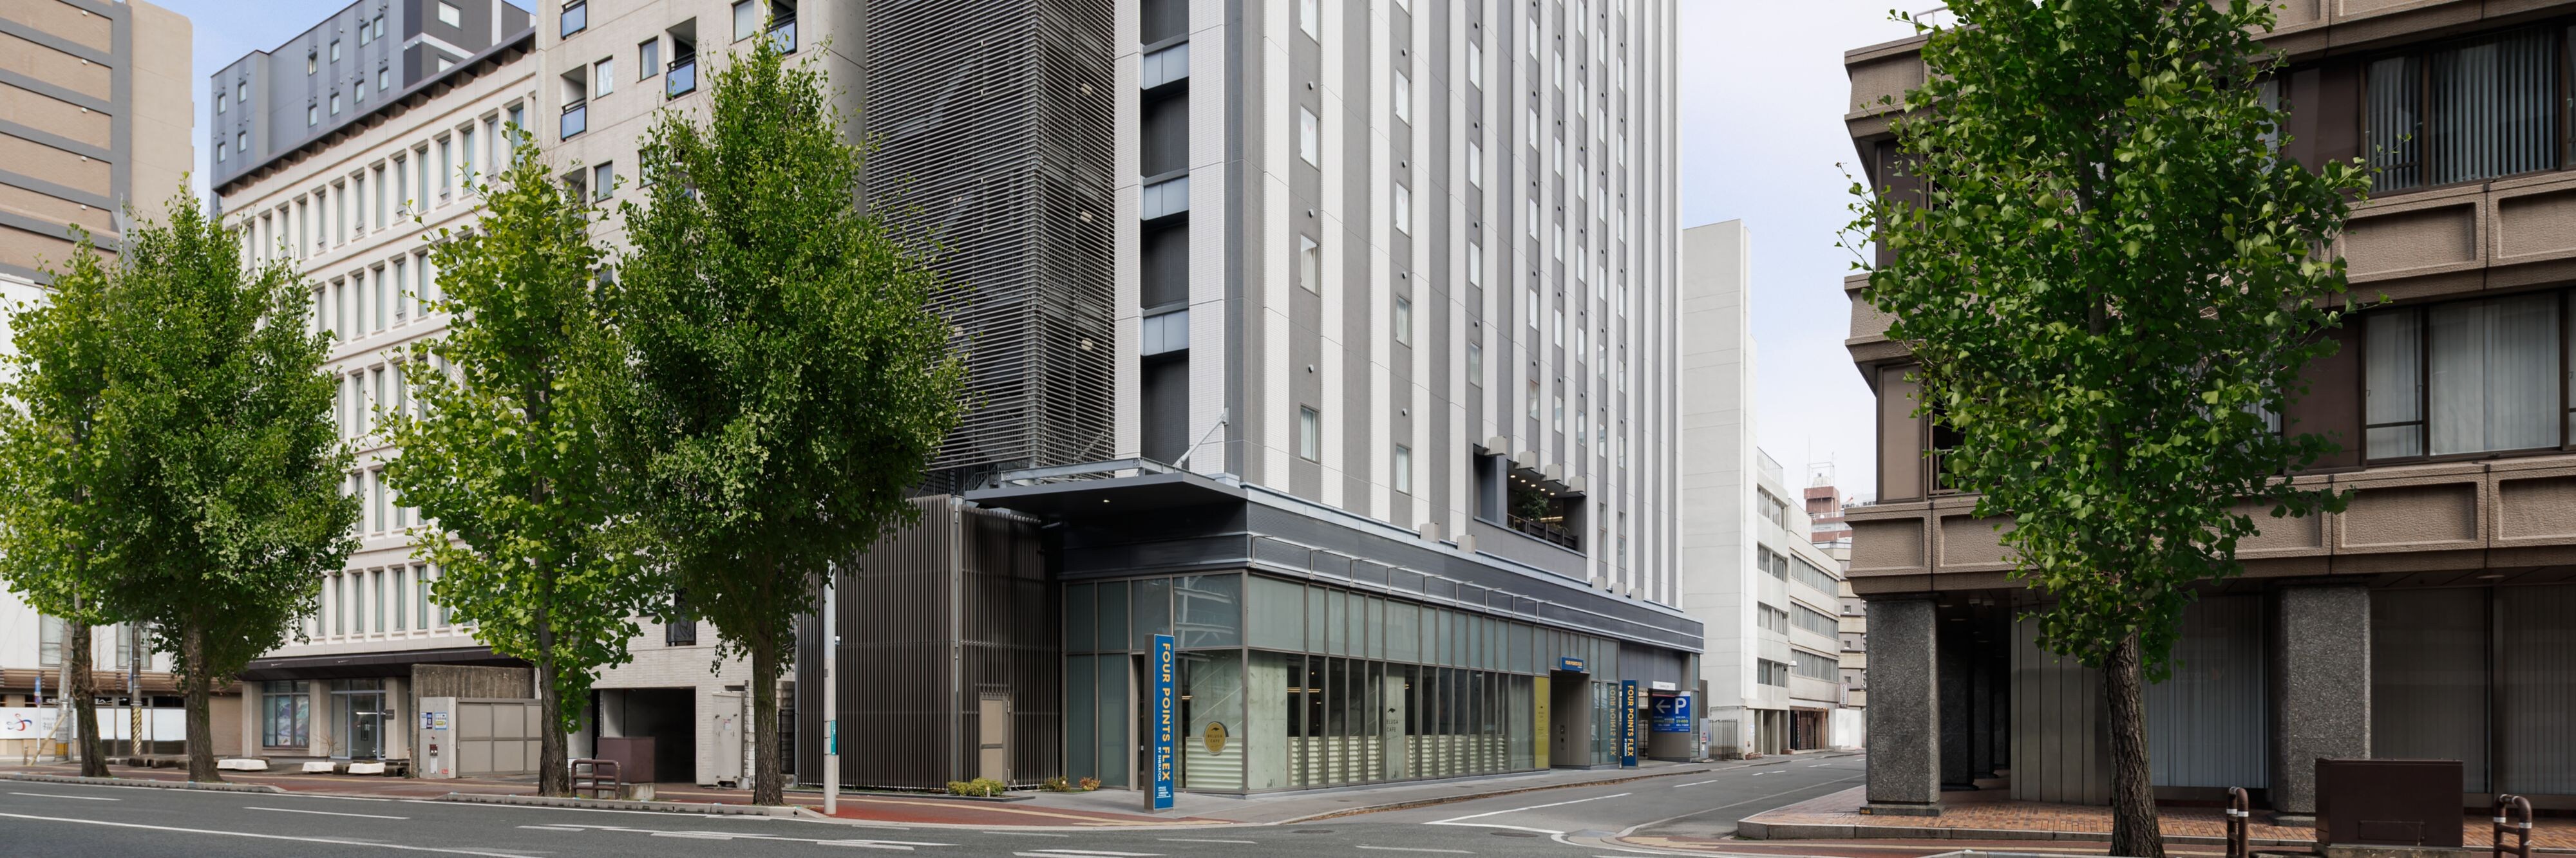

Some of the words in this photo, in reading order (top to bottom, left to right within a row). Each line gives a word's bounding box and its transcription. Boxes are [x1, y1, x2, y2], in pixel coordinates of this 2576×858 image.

[1162, 643, 1171, 682] FOUR
[1162, 687, 1171, 742] POINTS
[1675, 698, 1687, 714] P
[1162, 747, 1170, 781] FLEX
